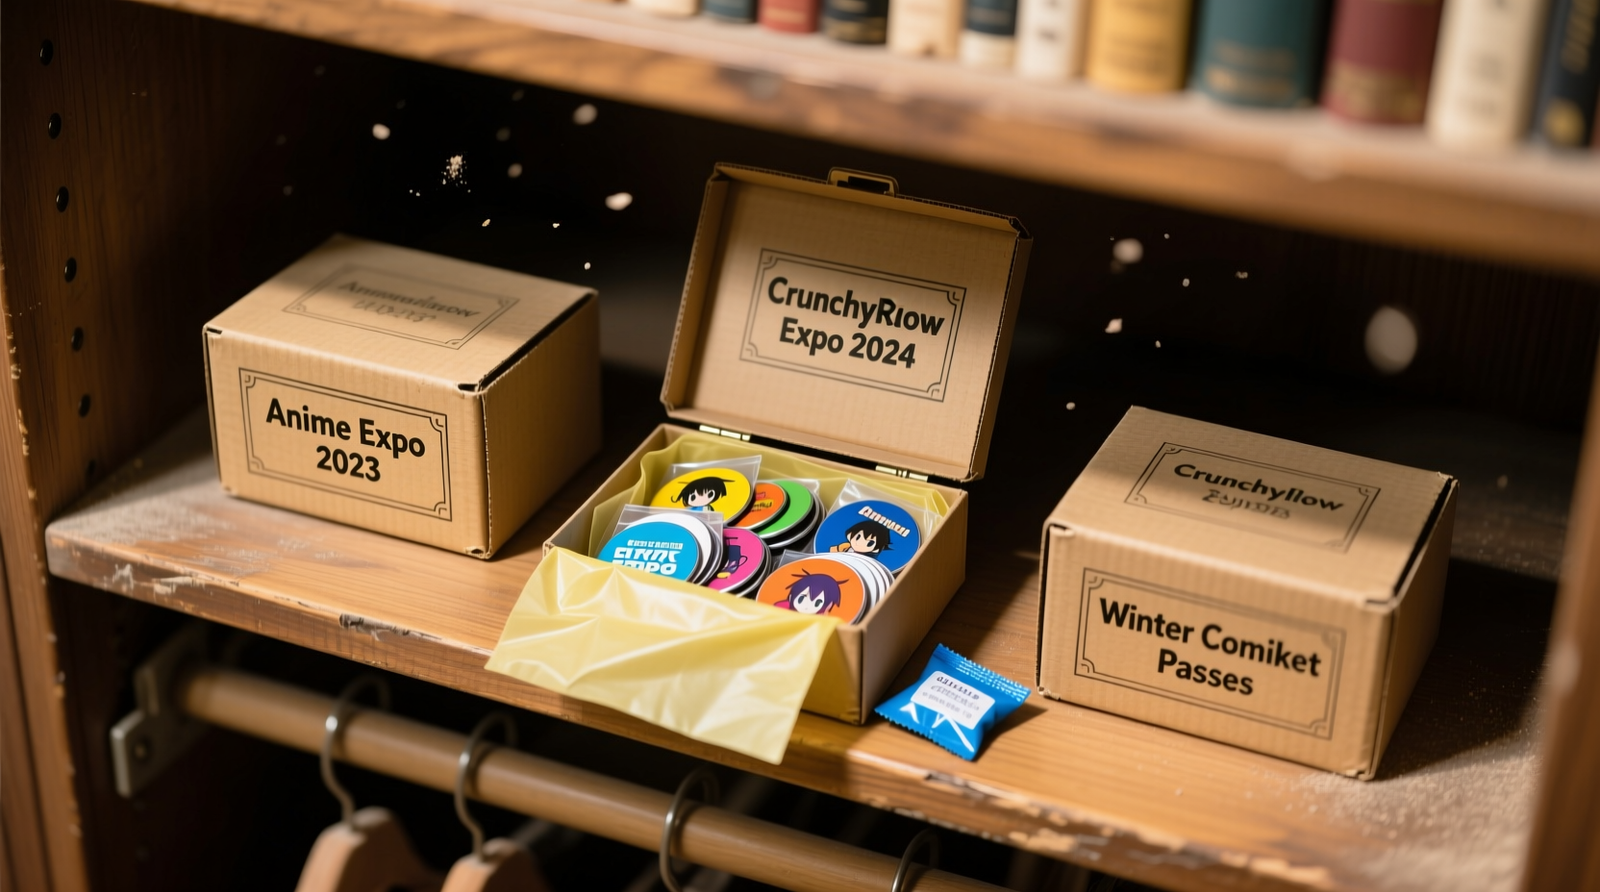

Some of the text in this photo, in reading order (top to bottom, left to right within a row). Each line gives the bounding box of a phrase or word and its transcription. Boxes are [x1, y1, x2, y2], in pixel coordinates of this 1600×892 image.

[779, 316, 916, 369] Expo 2024
[265, 397, 426, 458] Anime Expo
[316, 445, 381, 483] 2023
[1099, 597, 1322, 678] Winter Comiket
[1157, 648, 1254, 696] Passes
